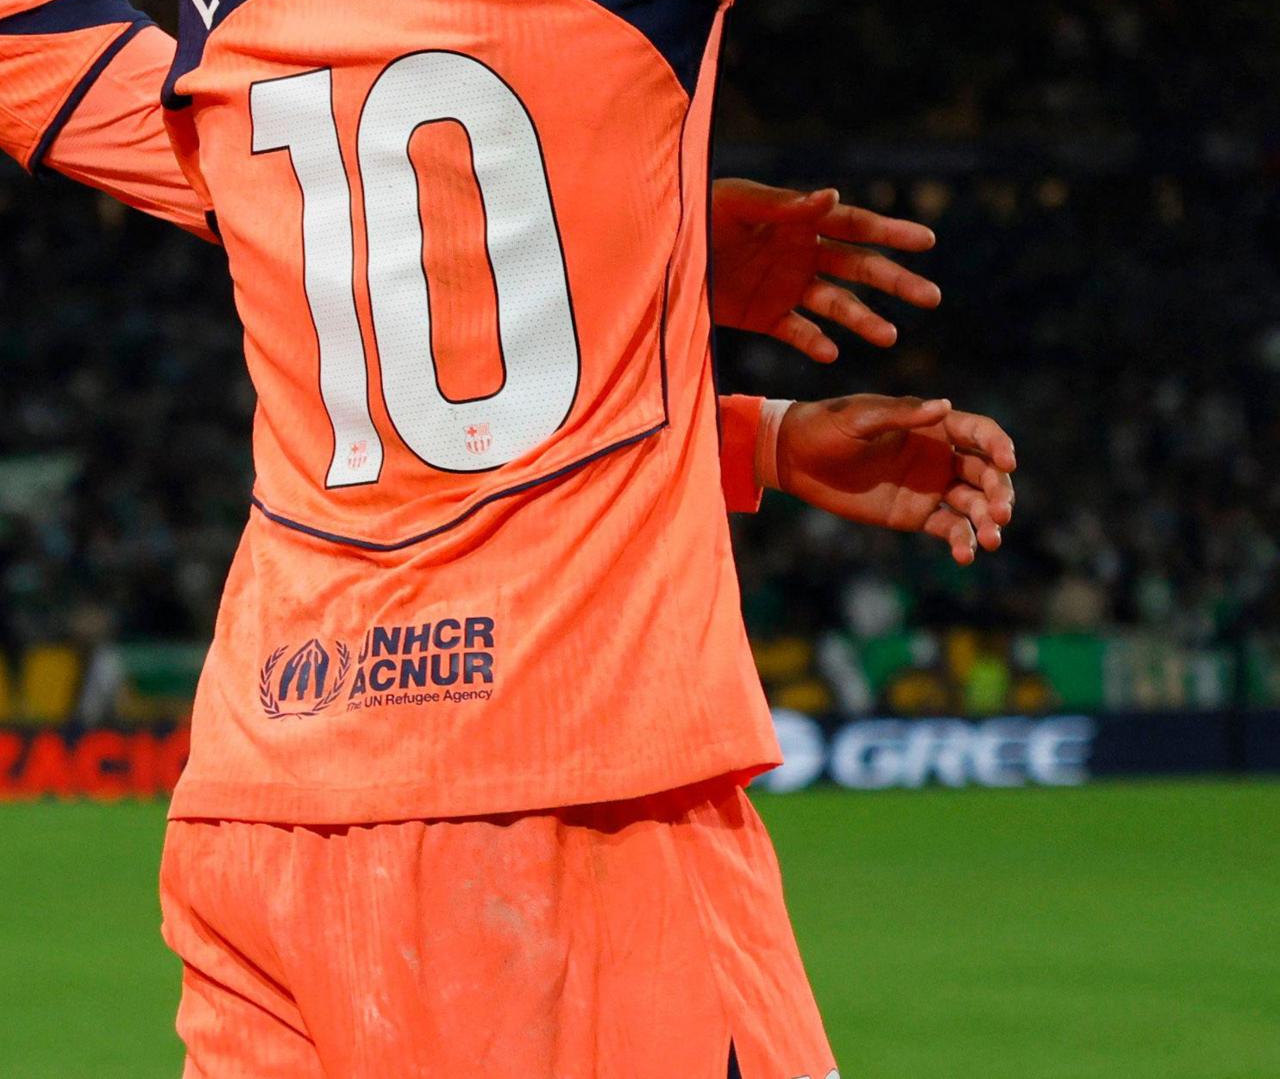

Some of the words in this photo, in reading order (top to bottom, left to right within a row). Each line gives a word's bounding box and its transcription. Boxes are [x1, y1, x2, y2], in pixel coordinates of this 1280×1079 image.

[249, 49, 582, 489] 10
[358, 616, 495, 664] UNHCR
[348, 652, 494, 700] ACNUR
[364, 695, 382, 708] UN
[385, 691, 440, 709] Refugee
[442, 687, 494, 704] Agency
[831, 715, 1097, 789] GREE
